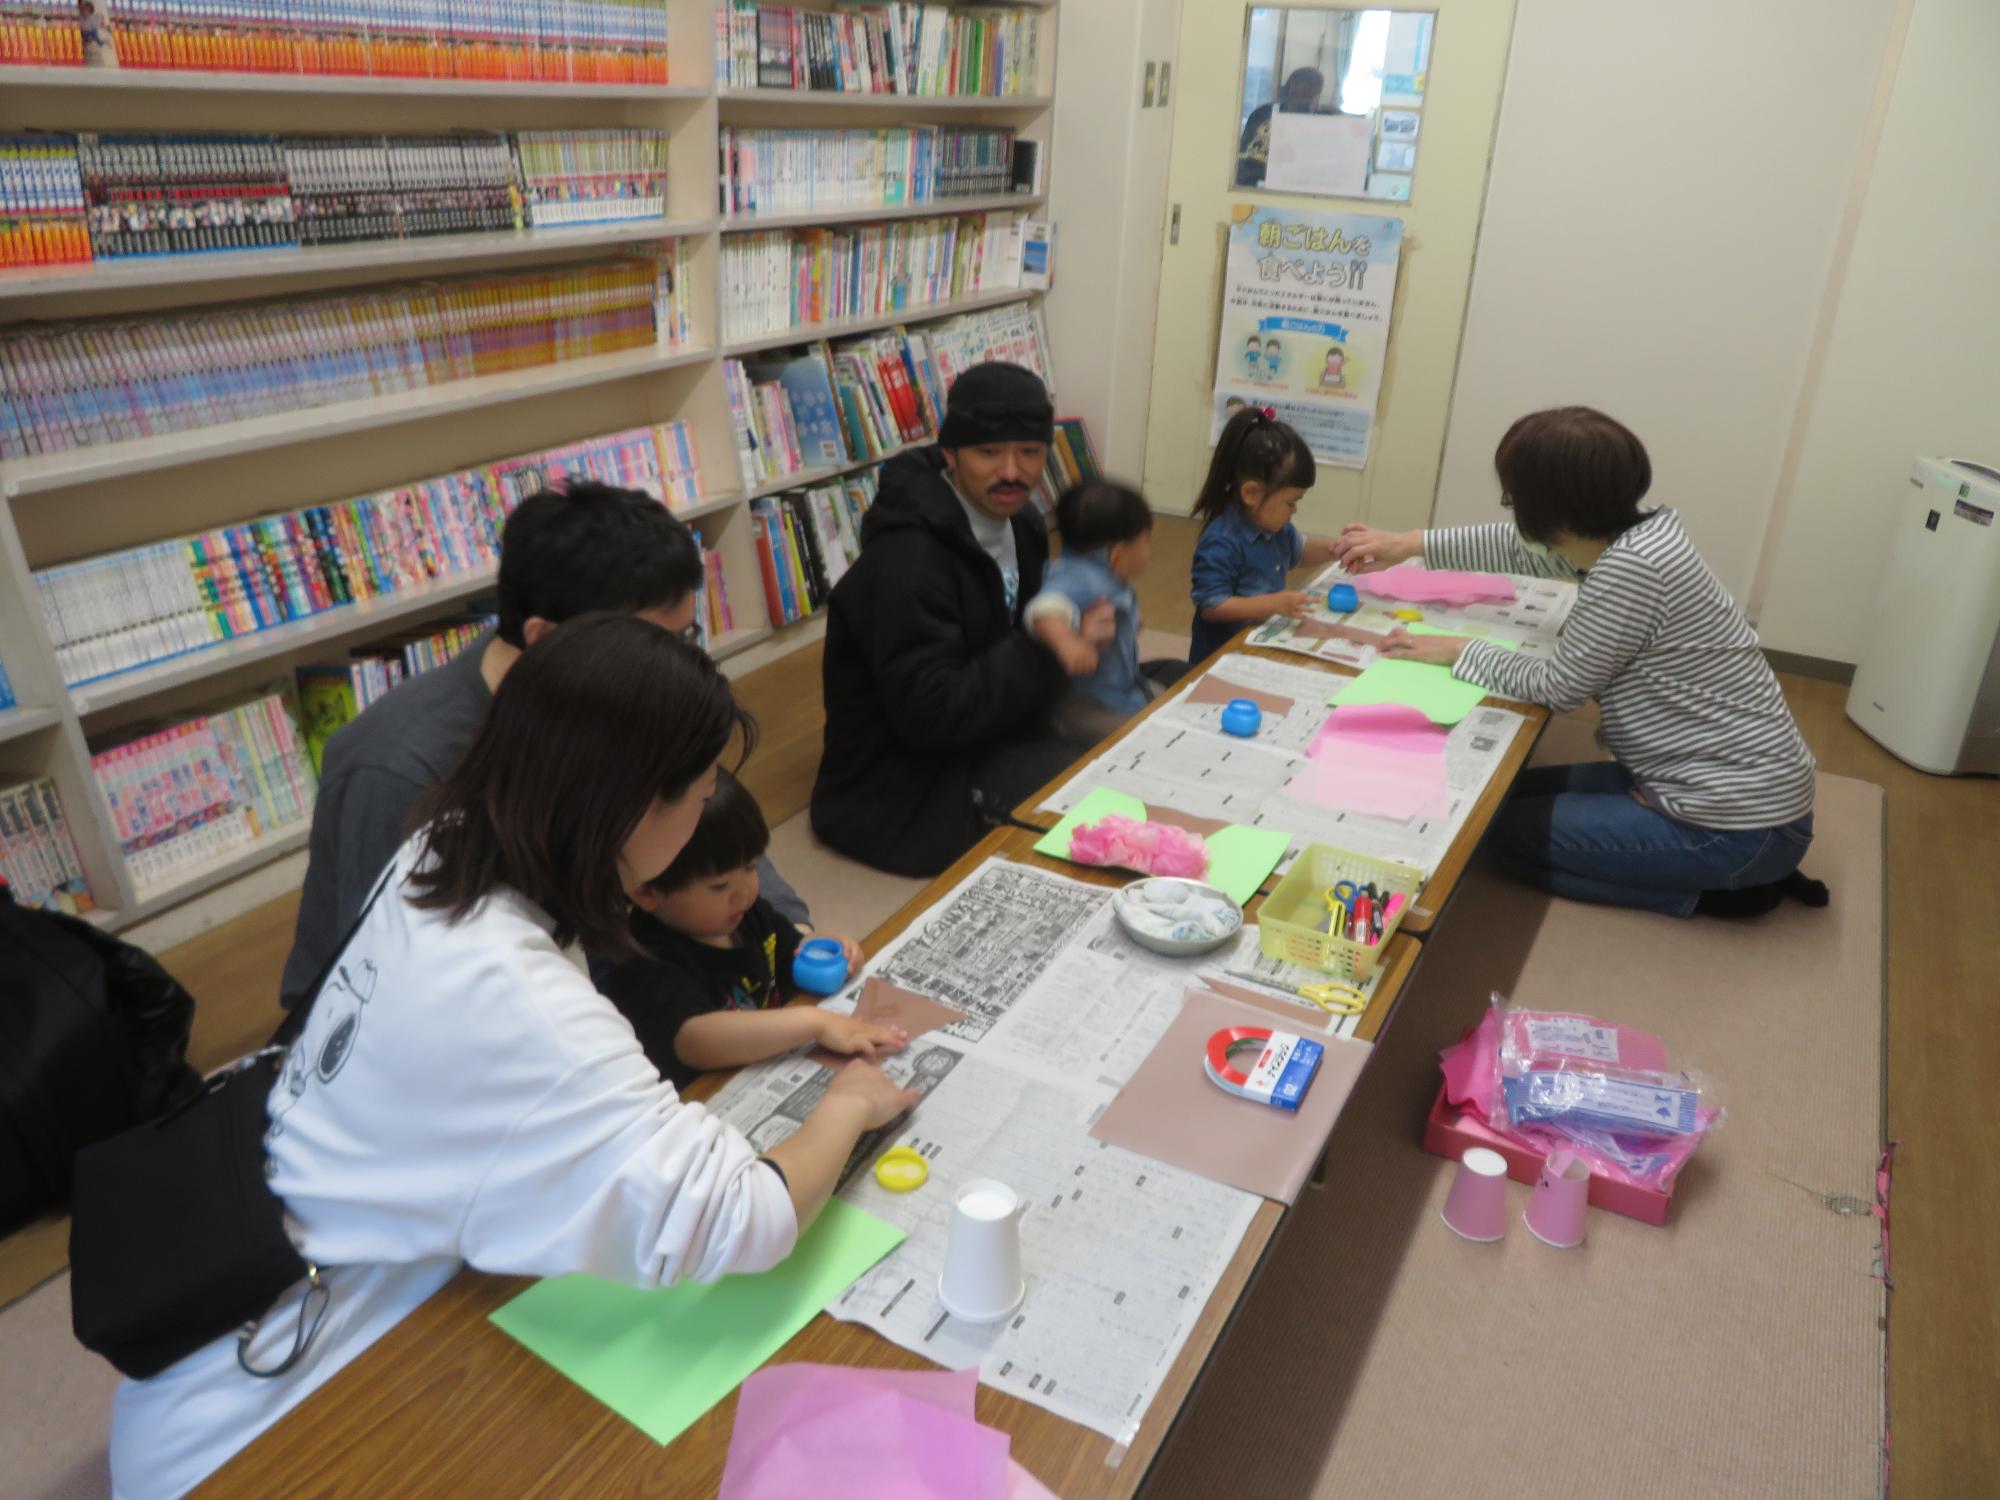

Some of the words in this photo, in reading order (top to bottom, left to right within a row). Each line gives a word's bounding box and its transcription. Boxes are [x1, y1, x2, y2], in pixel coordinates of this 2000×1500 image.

[1258, 218, 1371, 257] 朝ごはんを
